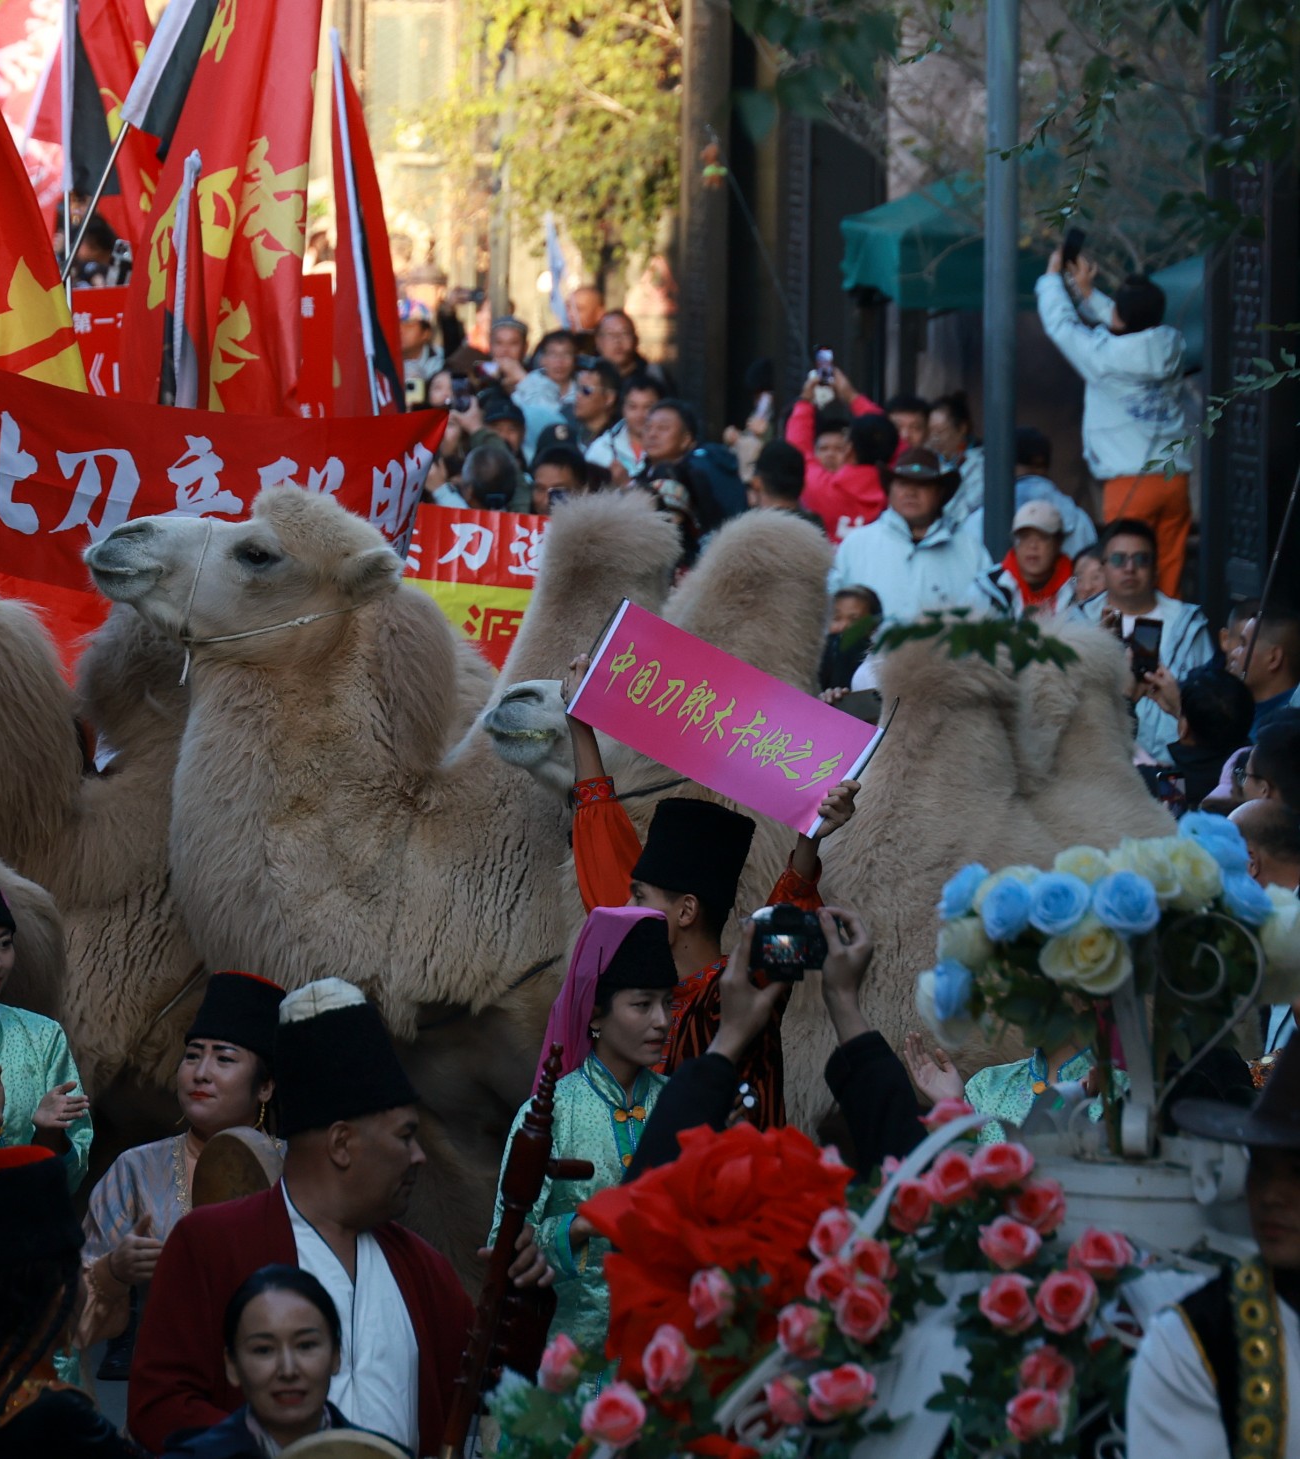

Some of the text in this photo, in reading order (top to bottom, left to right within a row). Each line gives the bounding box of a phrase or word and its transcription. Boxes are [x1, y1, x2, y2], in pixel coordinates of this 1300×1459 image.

[604, 642, 844, 791] 中国刀郎木卡姆之乡
